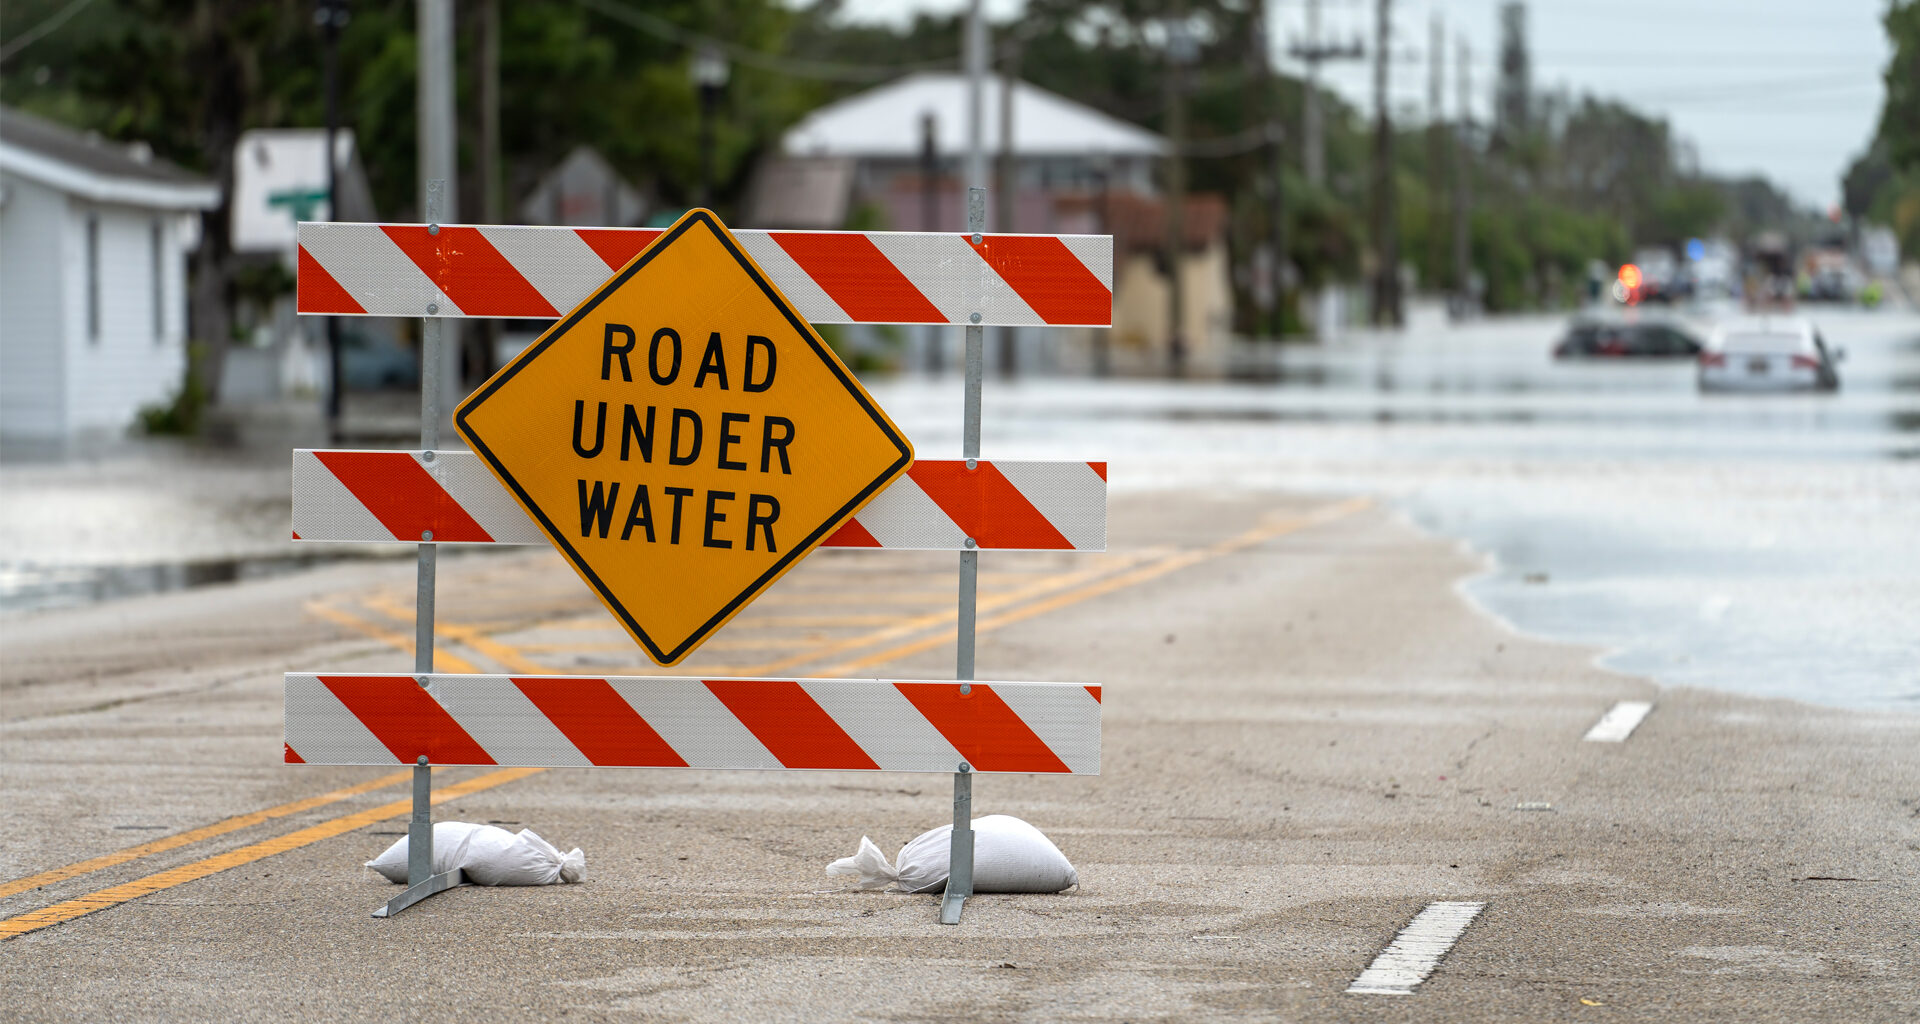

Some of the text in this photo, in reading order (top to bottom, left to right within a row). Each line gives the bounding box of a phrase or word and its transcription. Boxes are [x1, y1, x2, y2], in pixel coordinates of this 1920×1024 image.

[601, 323, 777, 392] ROAD
[572, 400, 795, 474] UNDER
[578, 479, 781, 552] WATER
